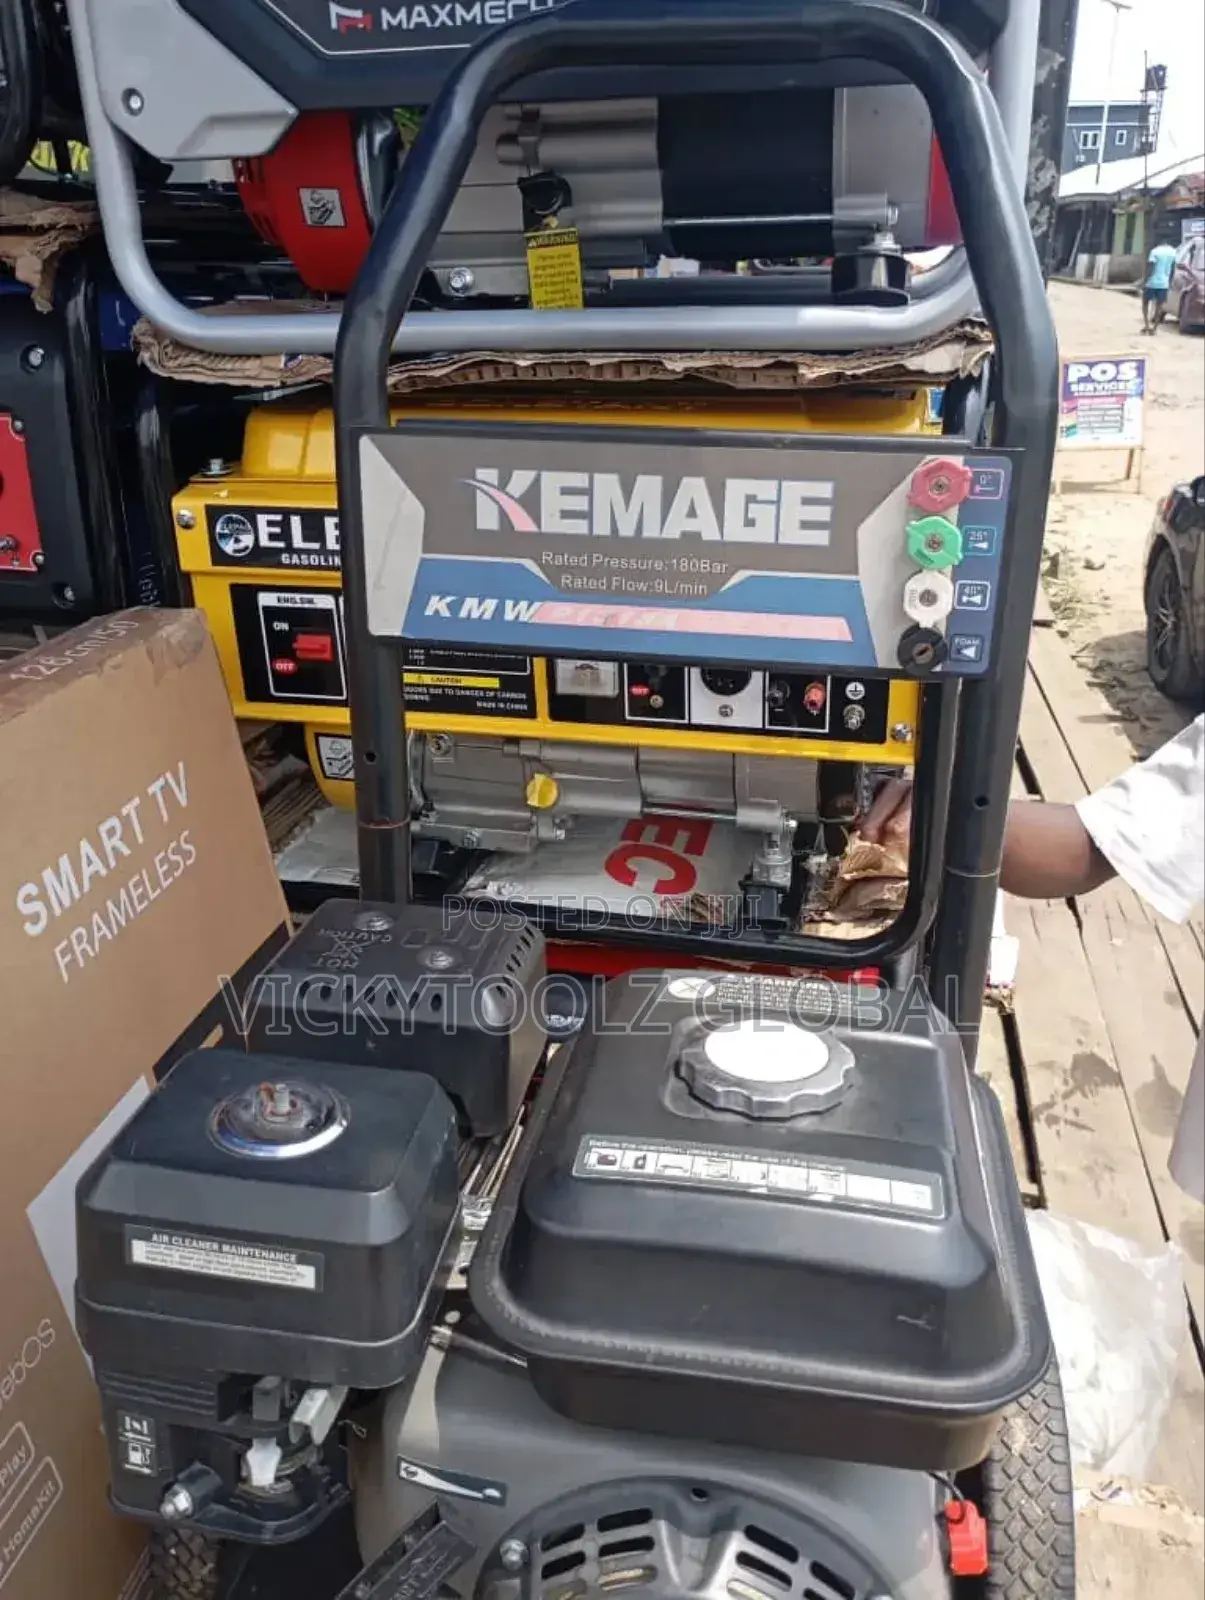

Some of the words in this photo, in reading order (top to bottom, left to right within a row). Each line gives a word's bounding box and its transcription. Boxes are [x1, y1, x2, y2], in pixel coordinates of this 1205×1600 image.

[1067, 361, 1138, 383] POS
[474, 468, 835, 546] KEMAGE
[542, 551, 588, 566] Rated
[561, 574, 607, 590] Rated
[273, 622, 290, 631] ON
[275, 662, 295, 672] OFF
[16, 796, 144, 937] SMART
[147, 760, 189, 823] TV
[54, 829, 197, 984] FRAMELESS
[151, 1232, 170, 1243] AIR
[171, 1235, 219, 1251] CLEANER
[222, 1243, 298, 1263] MAINTENANCE
